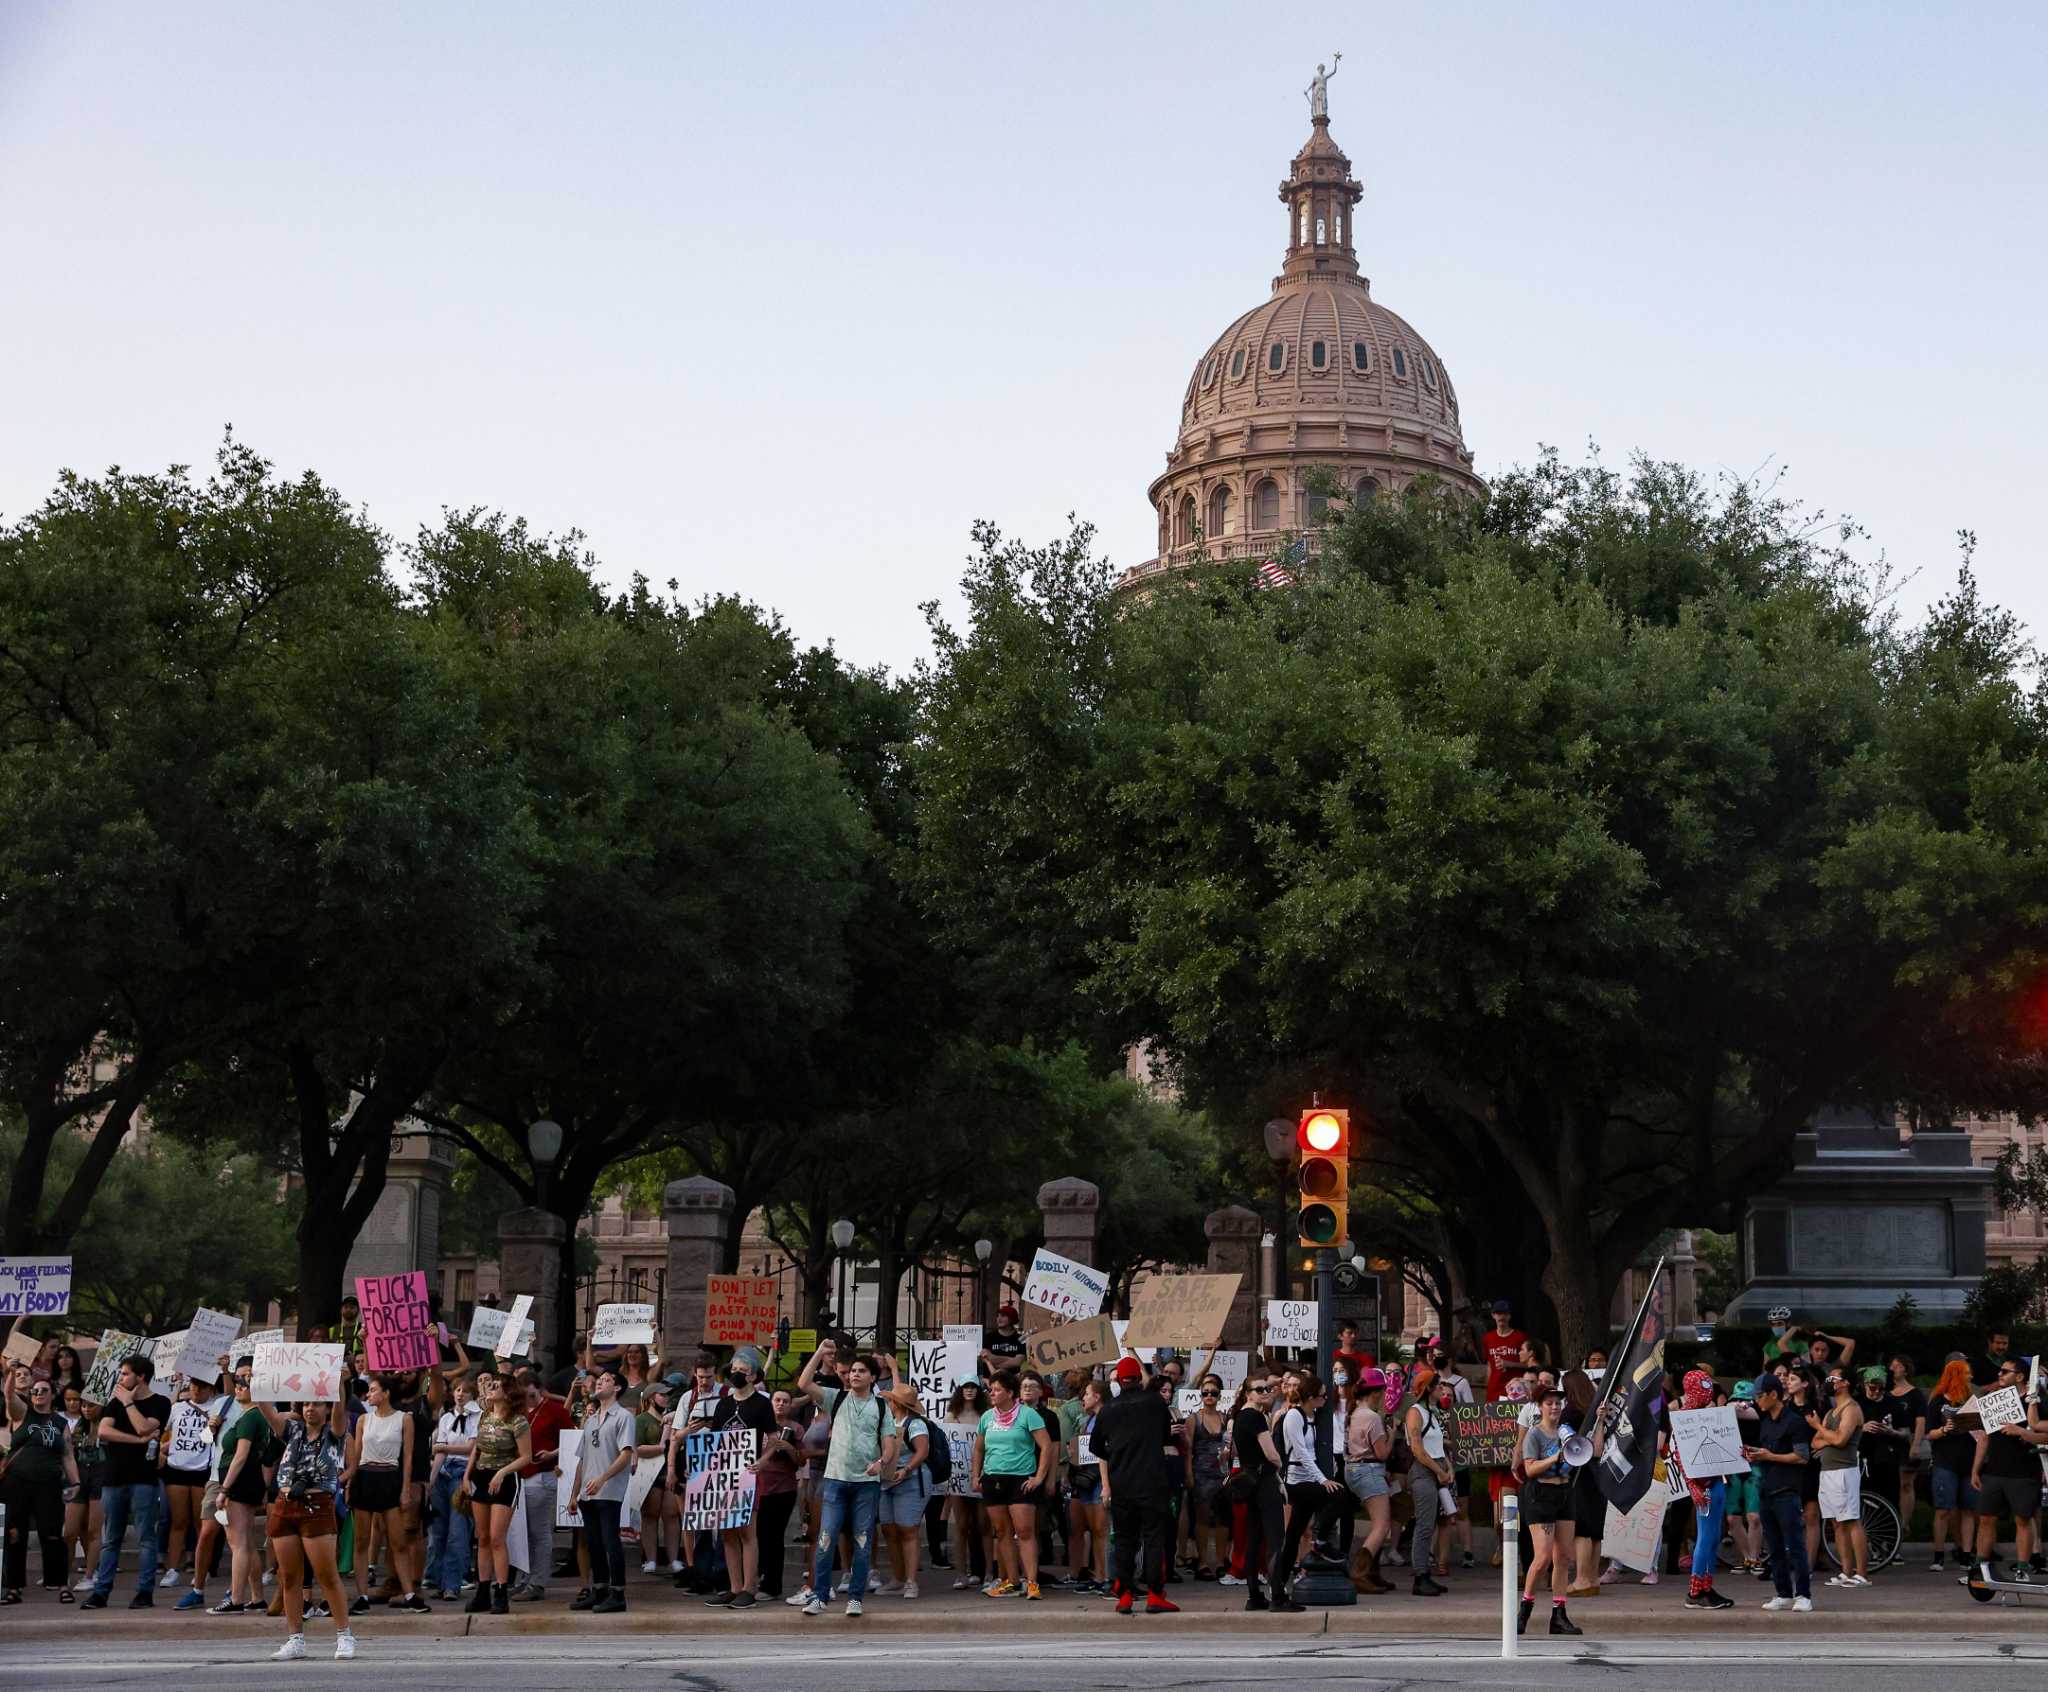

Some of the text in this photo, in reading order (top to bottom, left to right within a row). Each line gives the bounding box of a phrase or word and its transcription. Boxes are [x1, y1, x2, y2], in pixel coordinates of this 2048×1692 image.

[1036, 1260, 1070, 1274] BODILY
[364, 1273, 417, 1307] FUCK
[754, 1281, 775, 1296] LET
[1156, 1277, 1217, 1300] SAFE
[25, 1291, 68, 1312] BODY
[725, 1296, 749, 1305] THE
[1028, 1285, 1096, 1318] CORPSES
[1134, 1297, 1222, 1317] ABORTION
[1282, 1302, 1309, 1318] GOD
[362, 1301, 430, 1335] FORCED
[709, 1304, 777, 1319] BASTARDS
[709, 1320, 774, 1333] GRIND YOU
[1140, 1319, 1166, 1338] OR
[1288, 1317, 1299, 1328] IS
[720, 1331, 755, 1344] DOWN
[1272, 1327, 1318, 1341] PRO-CHOIC
[264, 1345, 309, 1367] HONK
[374, 1331, 432, 1369] BIRTH
[911, 1344, 947, 1375] WE
[1199, 1354, 1236, 1367] TRED
[910, 1377, 943, 1394] ARE
[1979, 1387, 2016, 1411] PROTECT
[1453, 1405, 1480, 1420] YOU
[1988, 1408, 2024, 1430] RIGHTS!
[1457, 1419, 1484, 1437] BAN
[689, 1431, 752, 1453] TRANS
[1456, 1438, 1473, 1449] YOU
[1479, 1436, 1493, 1447] CAN
[688, 1450, 755, 1473] RIGHTS
[1456, 1447, 1491, 1466] SAFE
[703, 1471, 740, 1491] ARE
[689, 1489, 754, 1511] HUMAN
[684, 1508, 752, 1531] RIGHTS
